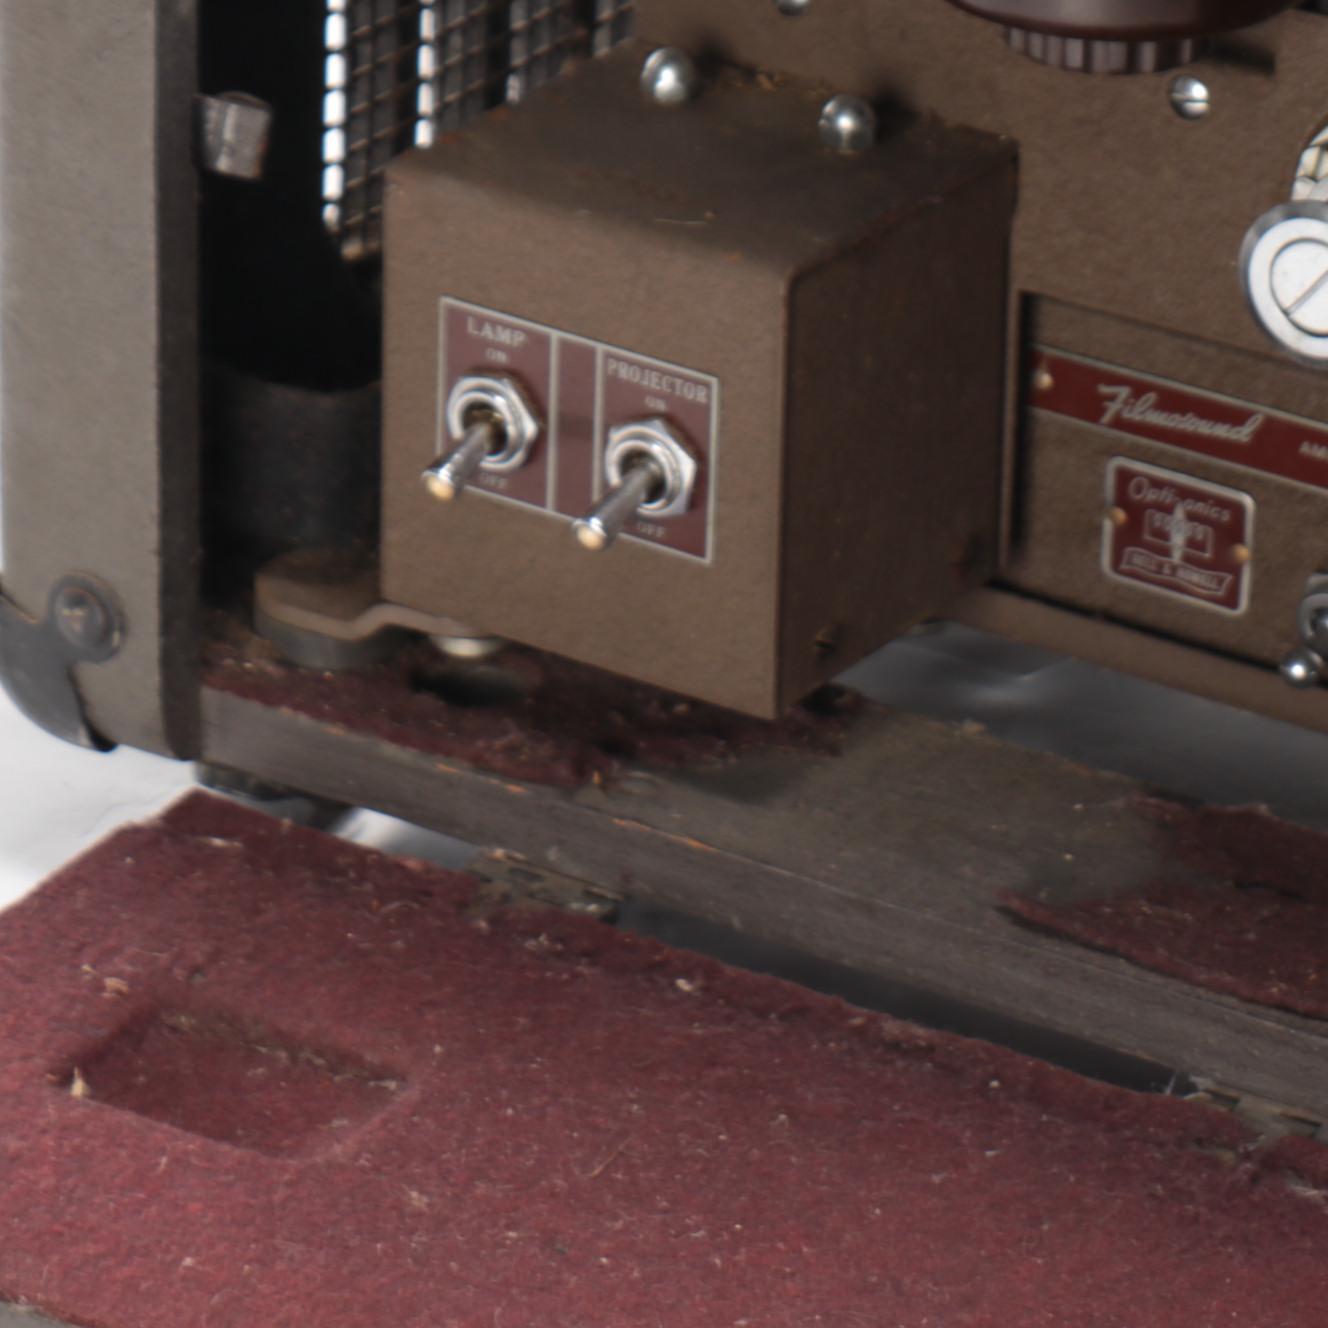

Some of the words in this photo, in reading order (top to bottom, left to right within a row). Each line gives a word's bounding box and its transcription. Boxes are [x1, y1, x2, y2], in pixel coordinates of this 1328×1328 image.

[467, 317, 527, 347] LAMP
[486, 348, 509, 364] ON
[606, 358, 710, 404] PROJECTOR
[645, 395, 667, 411] ON
[1097, 384, 1265, 443] Filmosound
